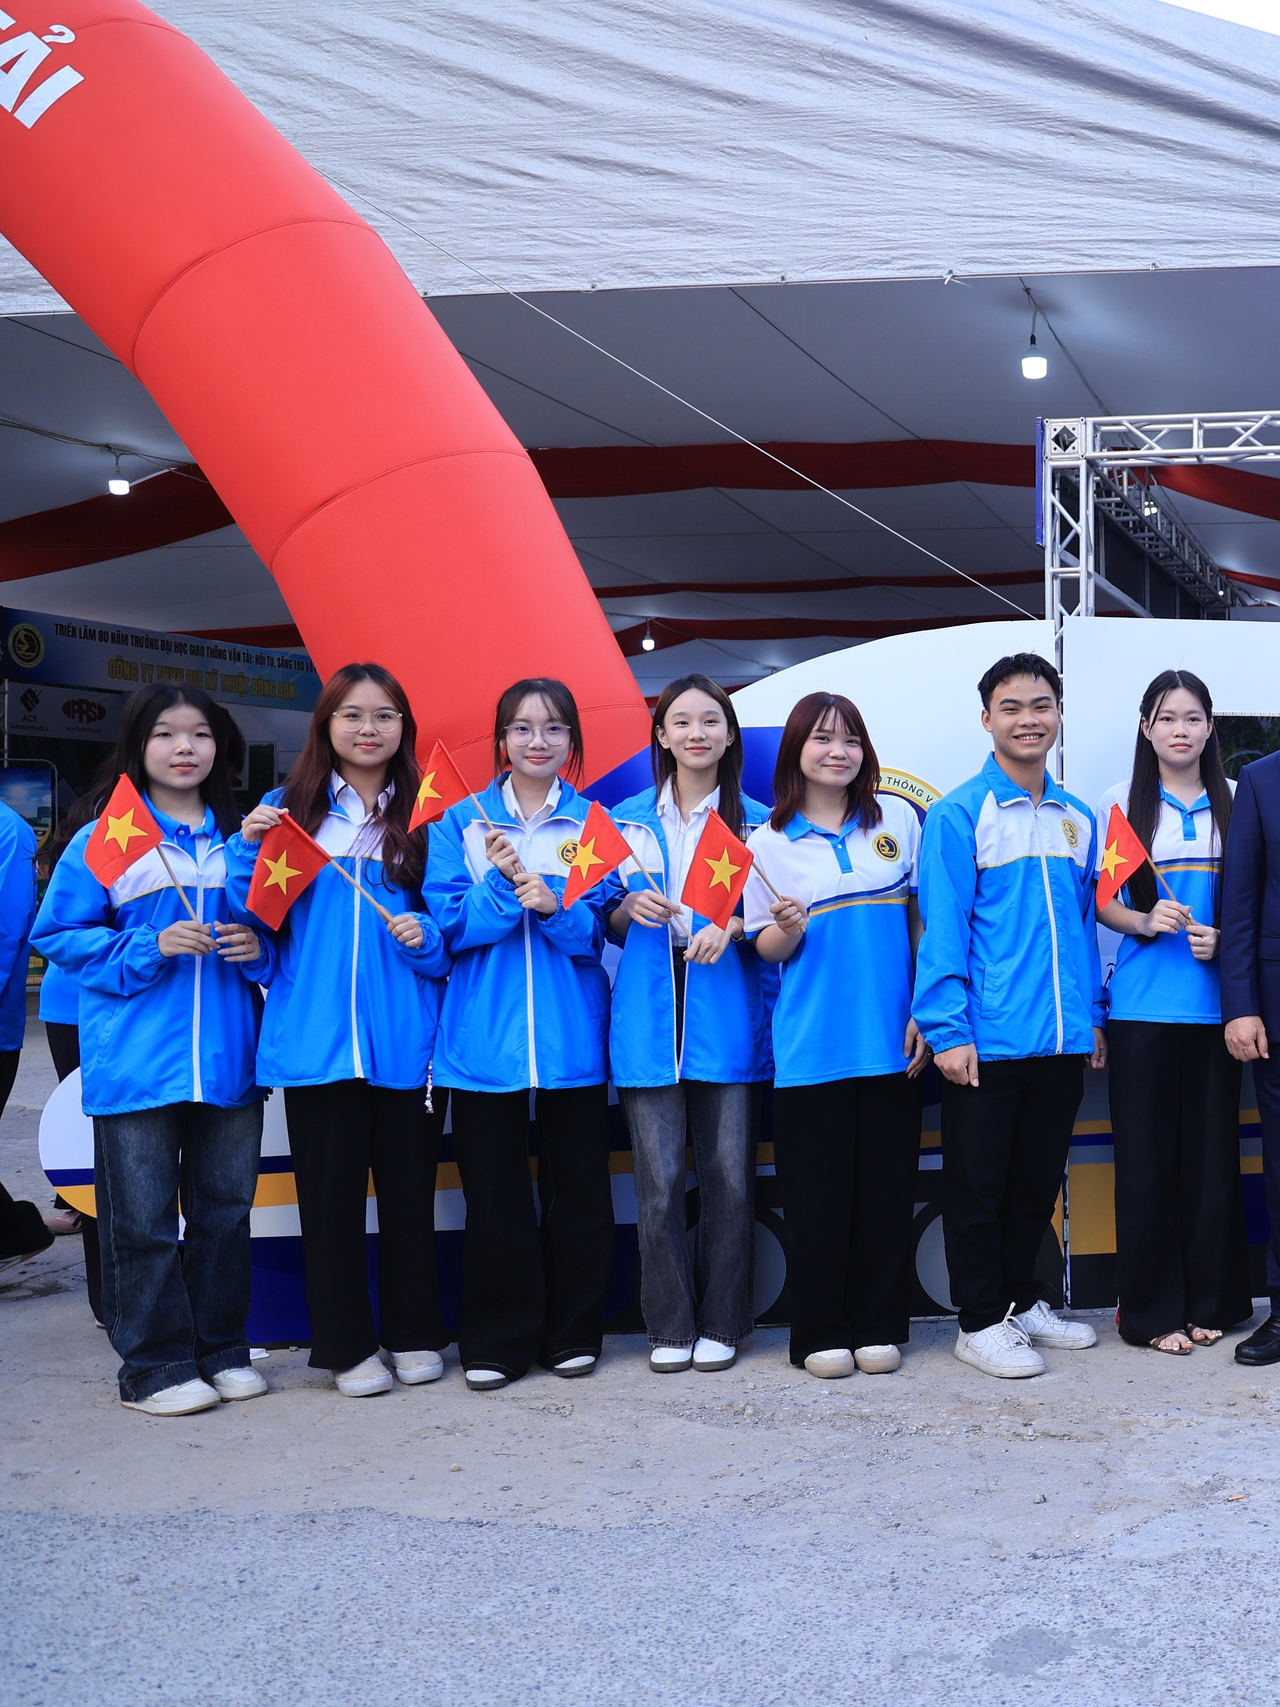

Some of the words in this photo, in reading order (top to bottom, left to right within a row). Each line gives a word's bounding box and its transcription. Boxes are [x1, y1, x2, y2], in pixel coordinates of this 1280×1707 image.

[0, 9, 85, 129] ẢI
[54, 622, 77, 639] TRIỂN
[79, 624, 96, 641] LÃM
[98, 630, 109, 643] 80
[111, 629, 129, 646] NĂM
[130, 633, 159, 650] TRƯỜNG
[160, 639, 172, 654] ĐẠI
[174, 641, 188, 656] HỌC
[189, 643, 204, 657] GIAO
[206, 645, 227, 660] THÔNG
[228, 648, 241, 664] VẬN
[255, 652, 266, 668] HỘI
[277, 656, 292, 670] SÁNG
[293, 660, 305, 673] TẠO
[108, 655, 138, 681] CÔNG
[141, 663, 154, 683] TY
[205, 669, 218, 690] KỸ
[220, 672, 249, 698] THUẬT
[277, 681, 295, 700] SƠN
[10, 722, 49, 732] Geosynthetics
[22, 715, 38, 723] ACE
[887, 776, 924, 797] THÔNG
